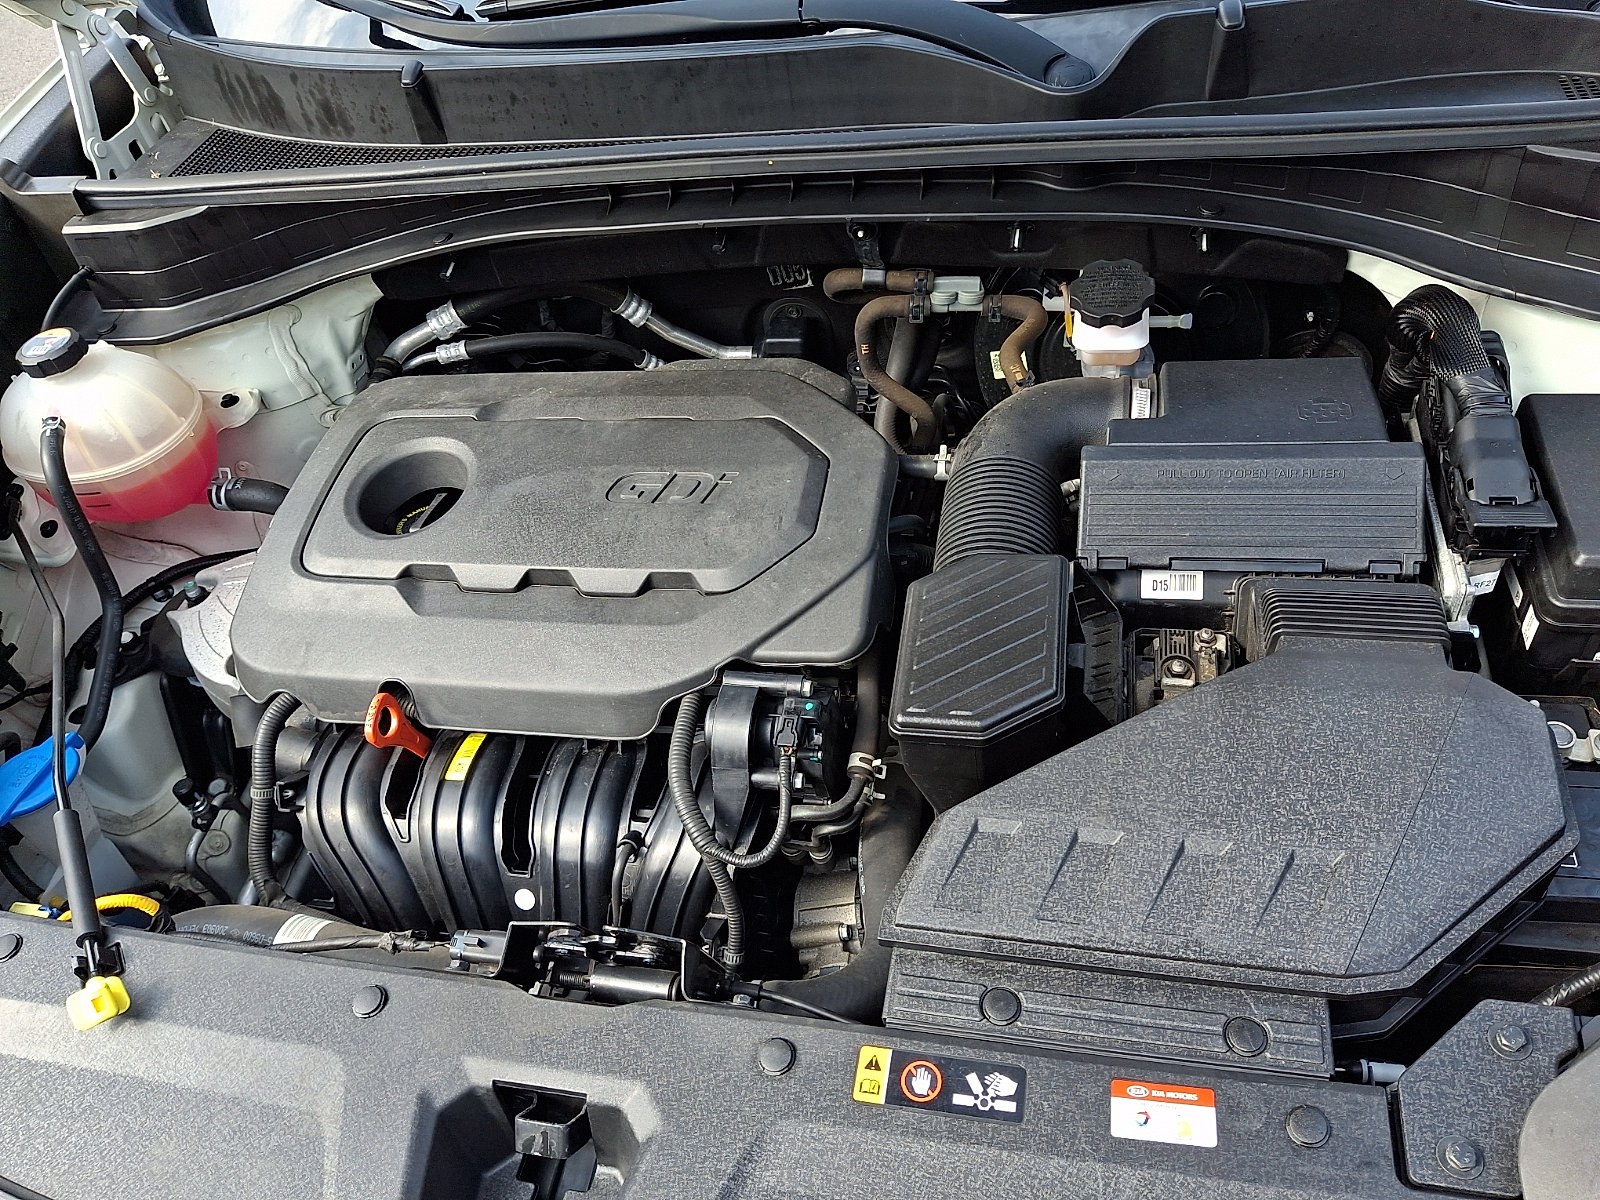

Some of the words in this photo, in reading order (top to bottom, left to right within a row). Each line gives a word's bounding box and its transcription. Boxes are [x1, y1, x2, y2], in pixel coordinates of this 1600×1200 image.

[1156, 468, 1186, 479] PULL
[1189, 468, 1213, 479] OUT
[1216, 468, 1231, 479] TO
[1234, 468, 1268, 479] OPEN
[1152, 579, 1169, 591] D15
